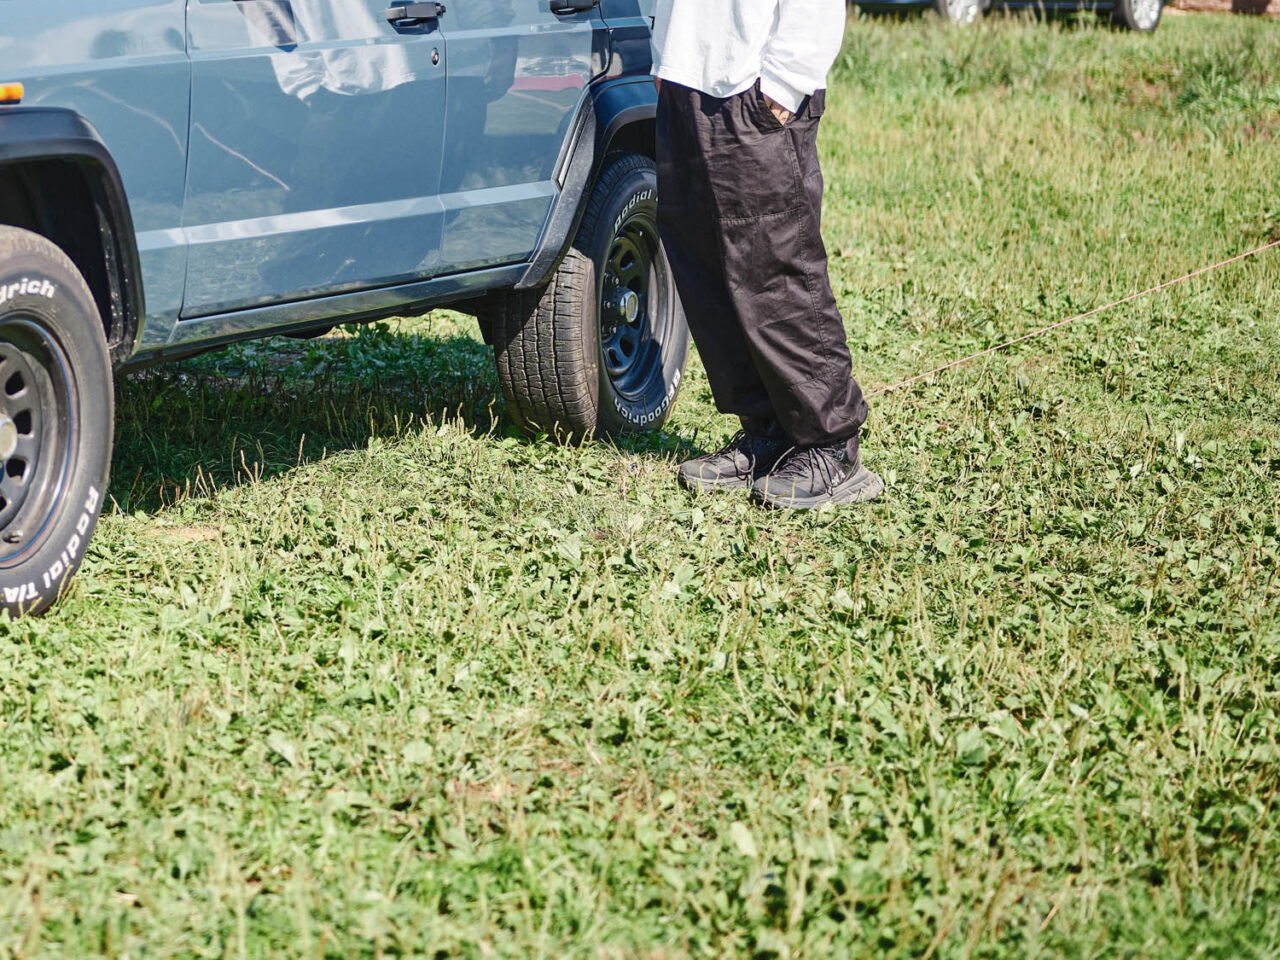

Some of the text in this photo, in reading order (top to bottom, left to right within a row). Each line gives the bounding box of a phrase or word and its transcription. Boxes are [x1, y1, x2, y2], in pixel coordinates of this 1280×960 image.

[614, 189, 652, 233] Radial
[614, 368, 681, 427] BFGoodrich
[2, 485, 99, 603] Radial T/A
